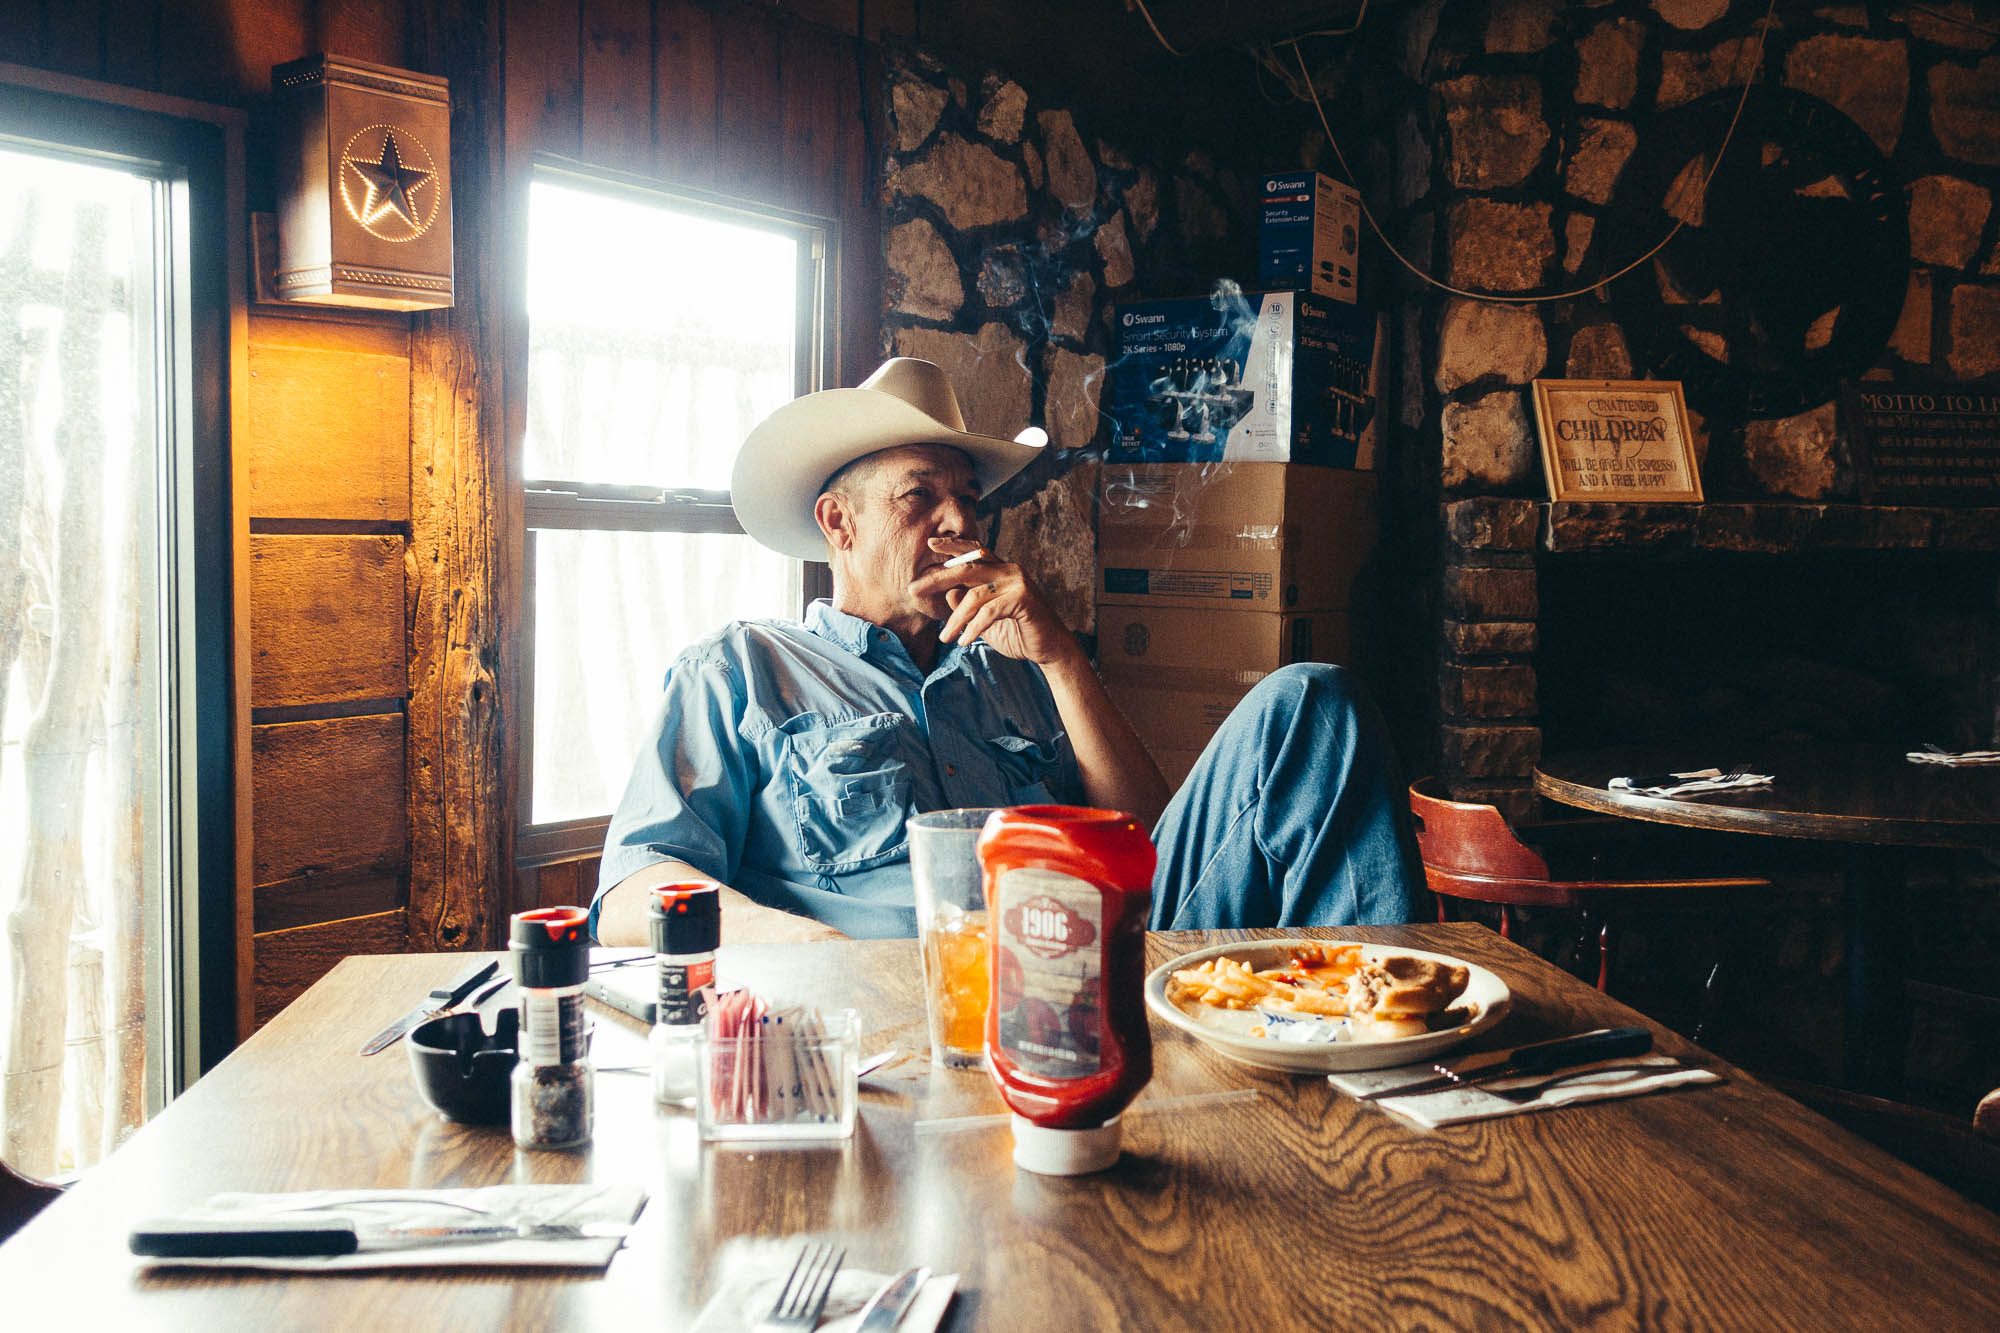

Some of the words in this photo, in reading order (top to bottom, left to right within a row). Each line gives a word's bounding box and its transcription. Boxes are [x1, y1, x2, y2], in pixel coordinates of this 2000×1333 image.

[1278, 181, 1305, 191] Swann
[1265, 209, 1288, 217] Security
[1265, 216, 1292, 224] Extension
[1271, 304, 1280, 312] 10
[1135, 313, 1165, 324] Swann
[1122, 331, 1151, 343] Smart
[1154, 328, 1193, 341] Security
[1194, 326, 1228, 339] System
[1134, 344, 1157, 353] Series
[1164, 343, 1186, 353] 1080p
[1593, 399, 1659, 413] UNATTENDED
[1860, 393, 1936, 411] MOTTO
[1943, 395, 1973, 411] TO
[1557, 418, 1667, 442] CHILDREN
[1562, 458, 1584, 472] WILL
[1586, 458, 1597, 471] BE
[1600, 459, 1623, 472] GIVEN
[1625, 459, 1636, 472] AN
[1638, 459, 1677, 472] ESPRESSO
[1579, 474, 1598, 487] AND
[1601, 474, 1608, 487] A
[1611, 474, 1635, 487] FREE
[1638, 474, 1666, 487] PUPPY
[1023, 906, 1068, 942] 1906
